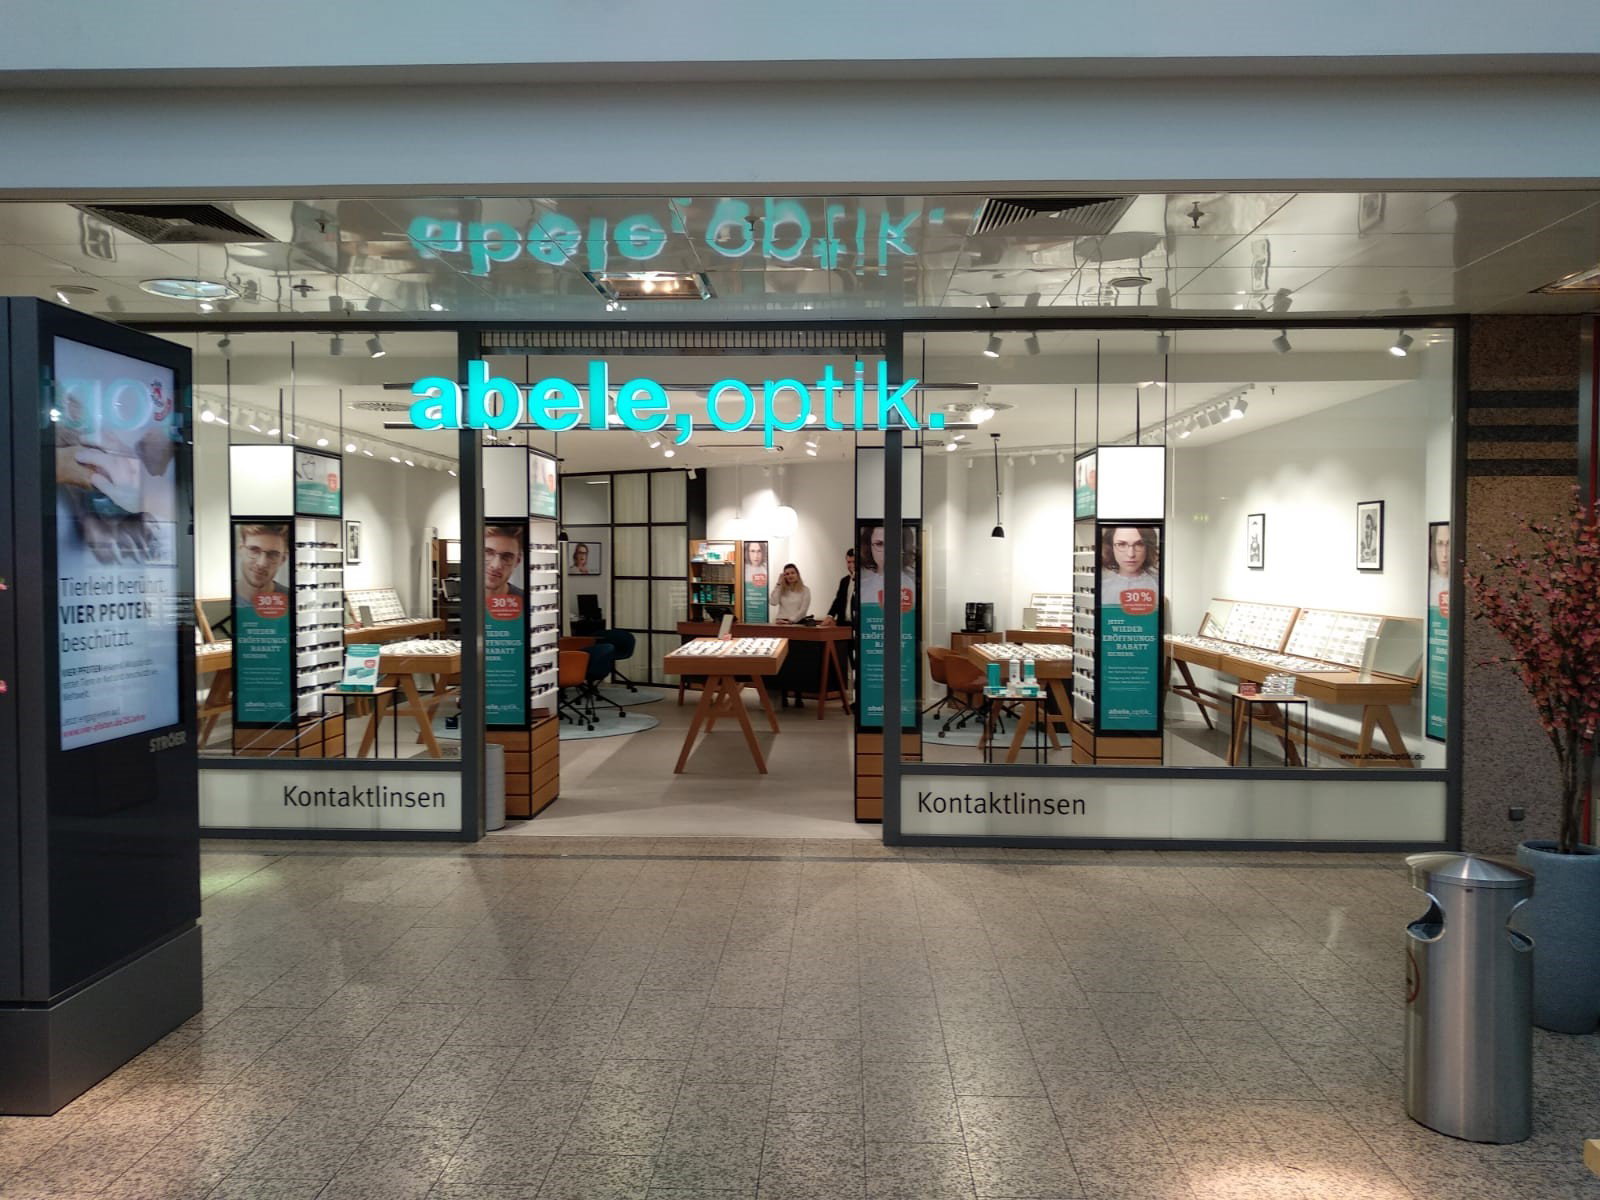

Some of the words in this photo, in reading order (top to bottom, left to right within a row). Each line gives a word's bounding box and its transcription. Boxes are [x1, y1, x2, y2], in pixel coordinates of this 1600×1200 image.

[408, 360, 693, 446] abele,
[706, 360, 945, 449] optik.
[61, 576, 115, 597] Tierleid
[60, 604, 96, 625] VIER
[99, 602, 152, 622] PFOTEN
[61, 628, 134, 653] beschützt.
[1111, 625, 1143, 633] WIEDER
[283, 784, 446, 808] Kontaktlinsen
[917, 791, 1086, 816] Kontaktlinsen
